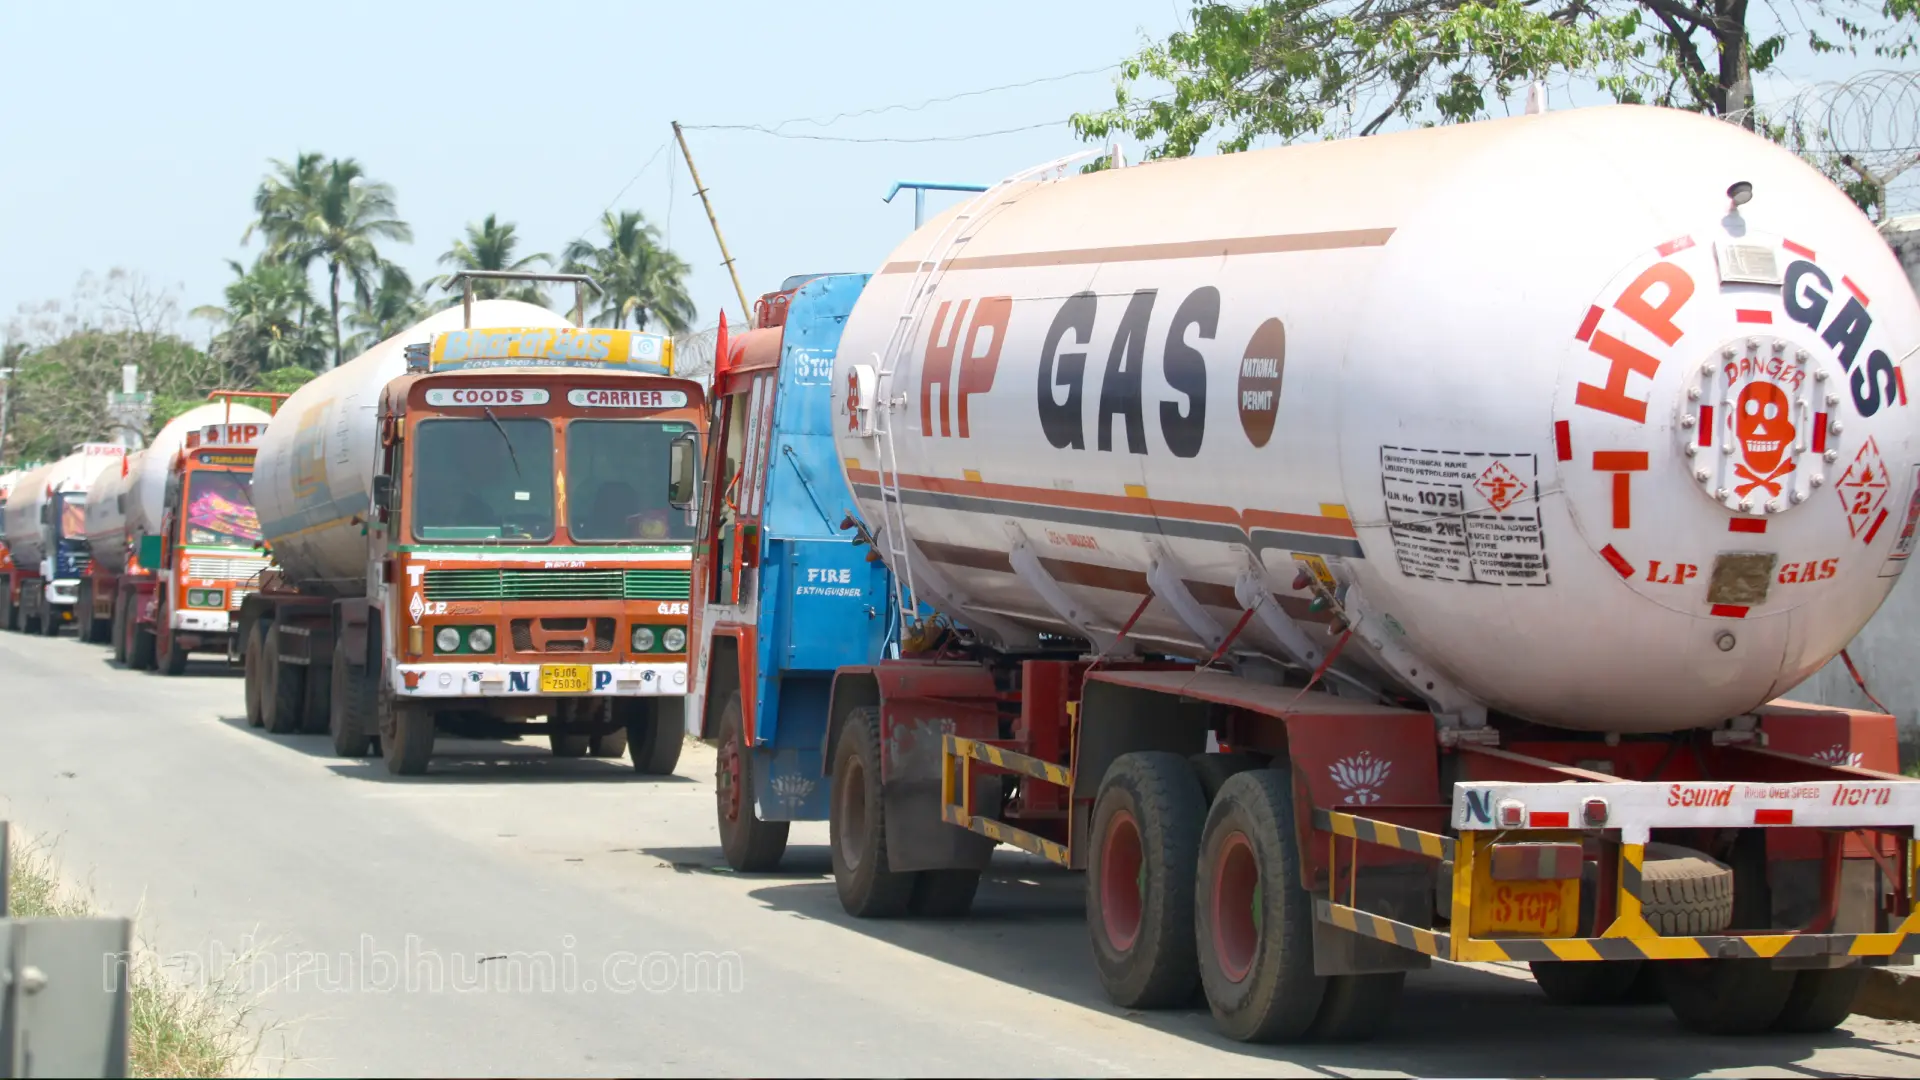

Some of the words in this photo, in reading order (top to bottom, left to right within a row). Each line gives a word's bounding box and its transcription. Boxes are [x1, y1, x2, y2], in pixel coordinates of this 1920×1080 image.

[1575, 261, 1695, 424] HP
[1783, 260, 1896, 418] GAS
[920, 296, 1013, 438] HP
[1037, 285, 1221, 458] GAS
[1242, 358, 1278, 378] NATIONAL
[1724, 356, 1806, 392] DANGER
[587, 391, 662, 406] CARRIER
[1243, 391, 1272, 410] PERMIT
[227, 425, 258, 444] HP
[1418, 491, 1460, 507] 1075
[1592, 451, 1649, 529] T
[1852, 491, 1872, 514] 2
[406, 565, 425, 587] T
[807, 568, 851, 584] FIRE
[1777, 557, 1839, 584] GAS
[796, 586, 861, 597] EXTINGUISHER
[658, 601, 689, 615] GAS
[508, 671, 530, 691] N
[595, 671, 612, 690] P
[554, 668, 577, 677] GJ06
[1668, 784, 1735, 807] Sound
[1832, 783, 1891, 806] horn
[1465, 790, 1492, 824] N
